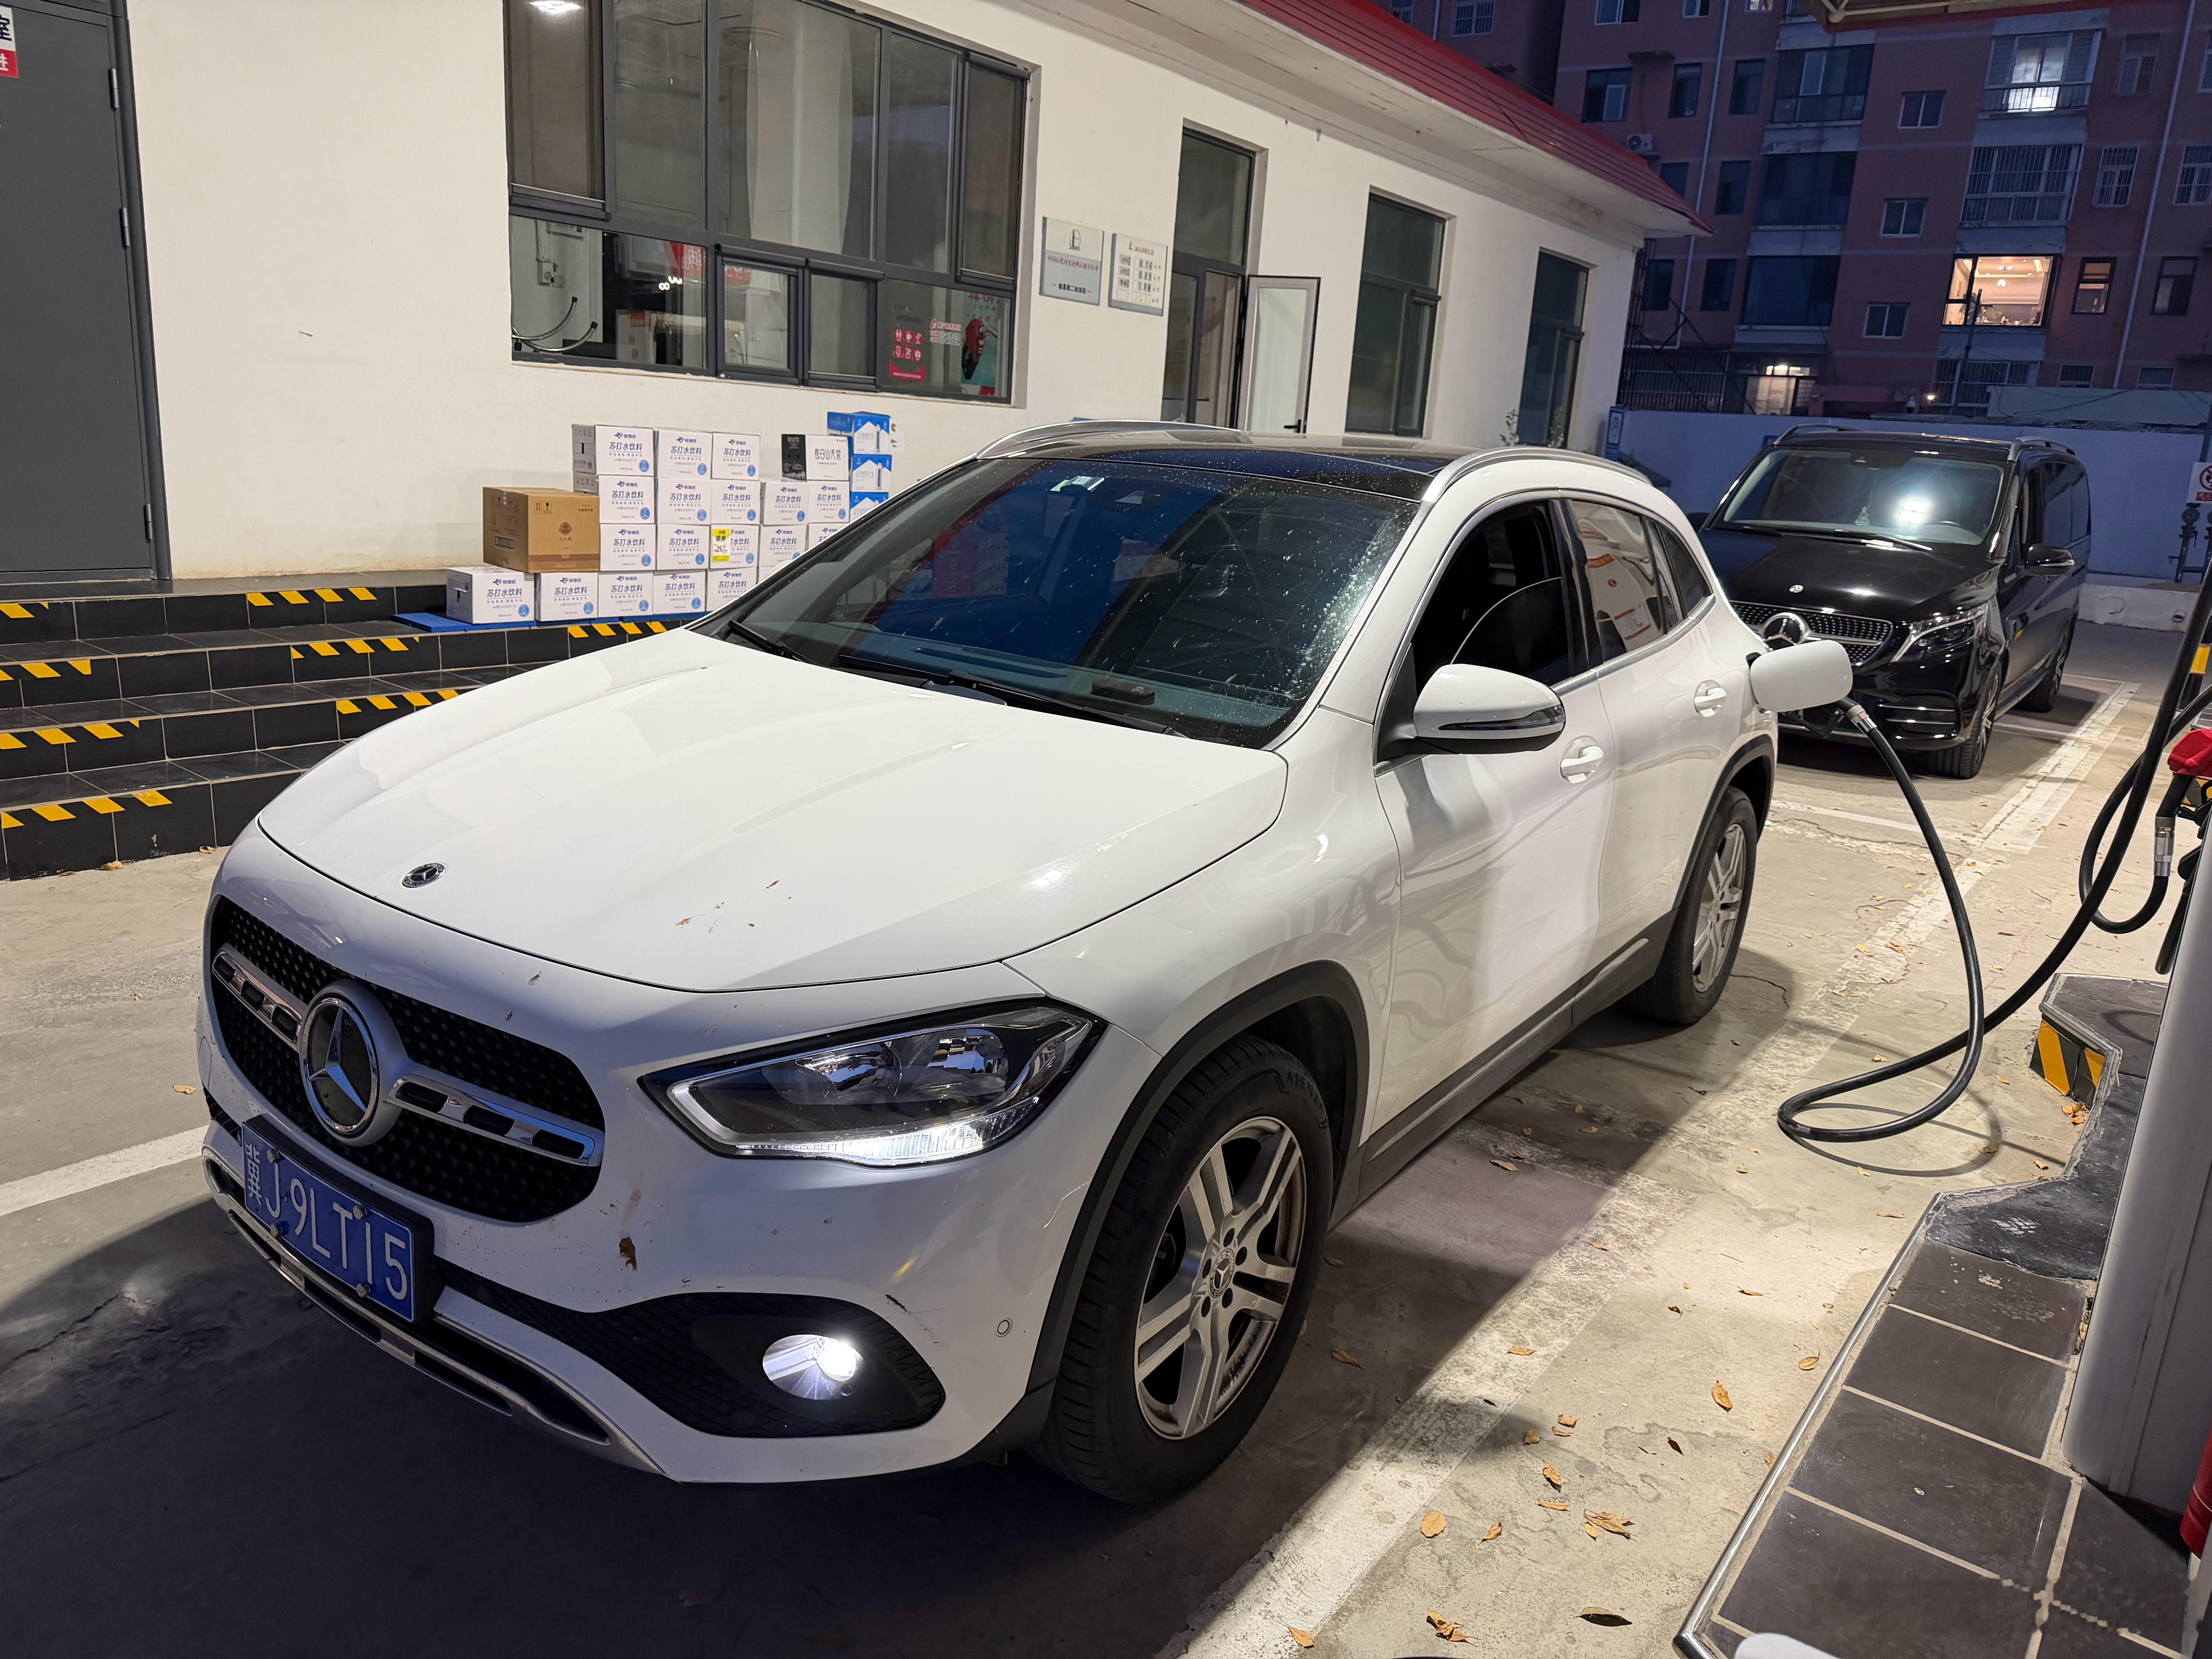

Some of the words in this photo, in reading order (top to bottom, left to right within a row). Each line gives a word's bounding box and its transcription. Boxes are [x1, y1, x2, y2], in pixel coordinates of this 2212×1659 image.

[609, 442, 642, 451] 苏打水饮料
[670, 446, 702, 455] 苏打水饮料
[723, 448, 751, 457] 苏打水饮料
[611, 491, 644, 499] 苏打水饮料
[670, 493, 701, 501] 苏打水饮料
[613, 538, 645, 546] 苏打水饮料
[669, 538, 699, 546] 苏打水饮料
[554, 586, 587, 595] 苏打水饮料
[665, 583, 695, 591] 苏打水饮料
[487, 588, 522, 597] 苏打水饮料
